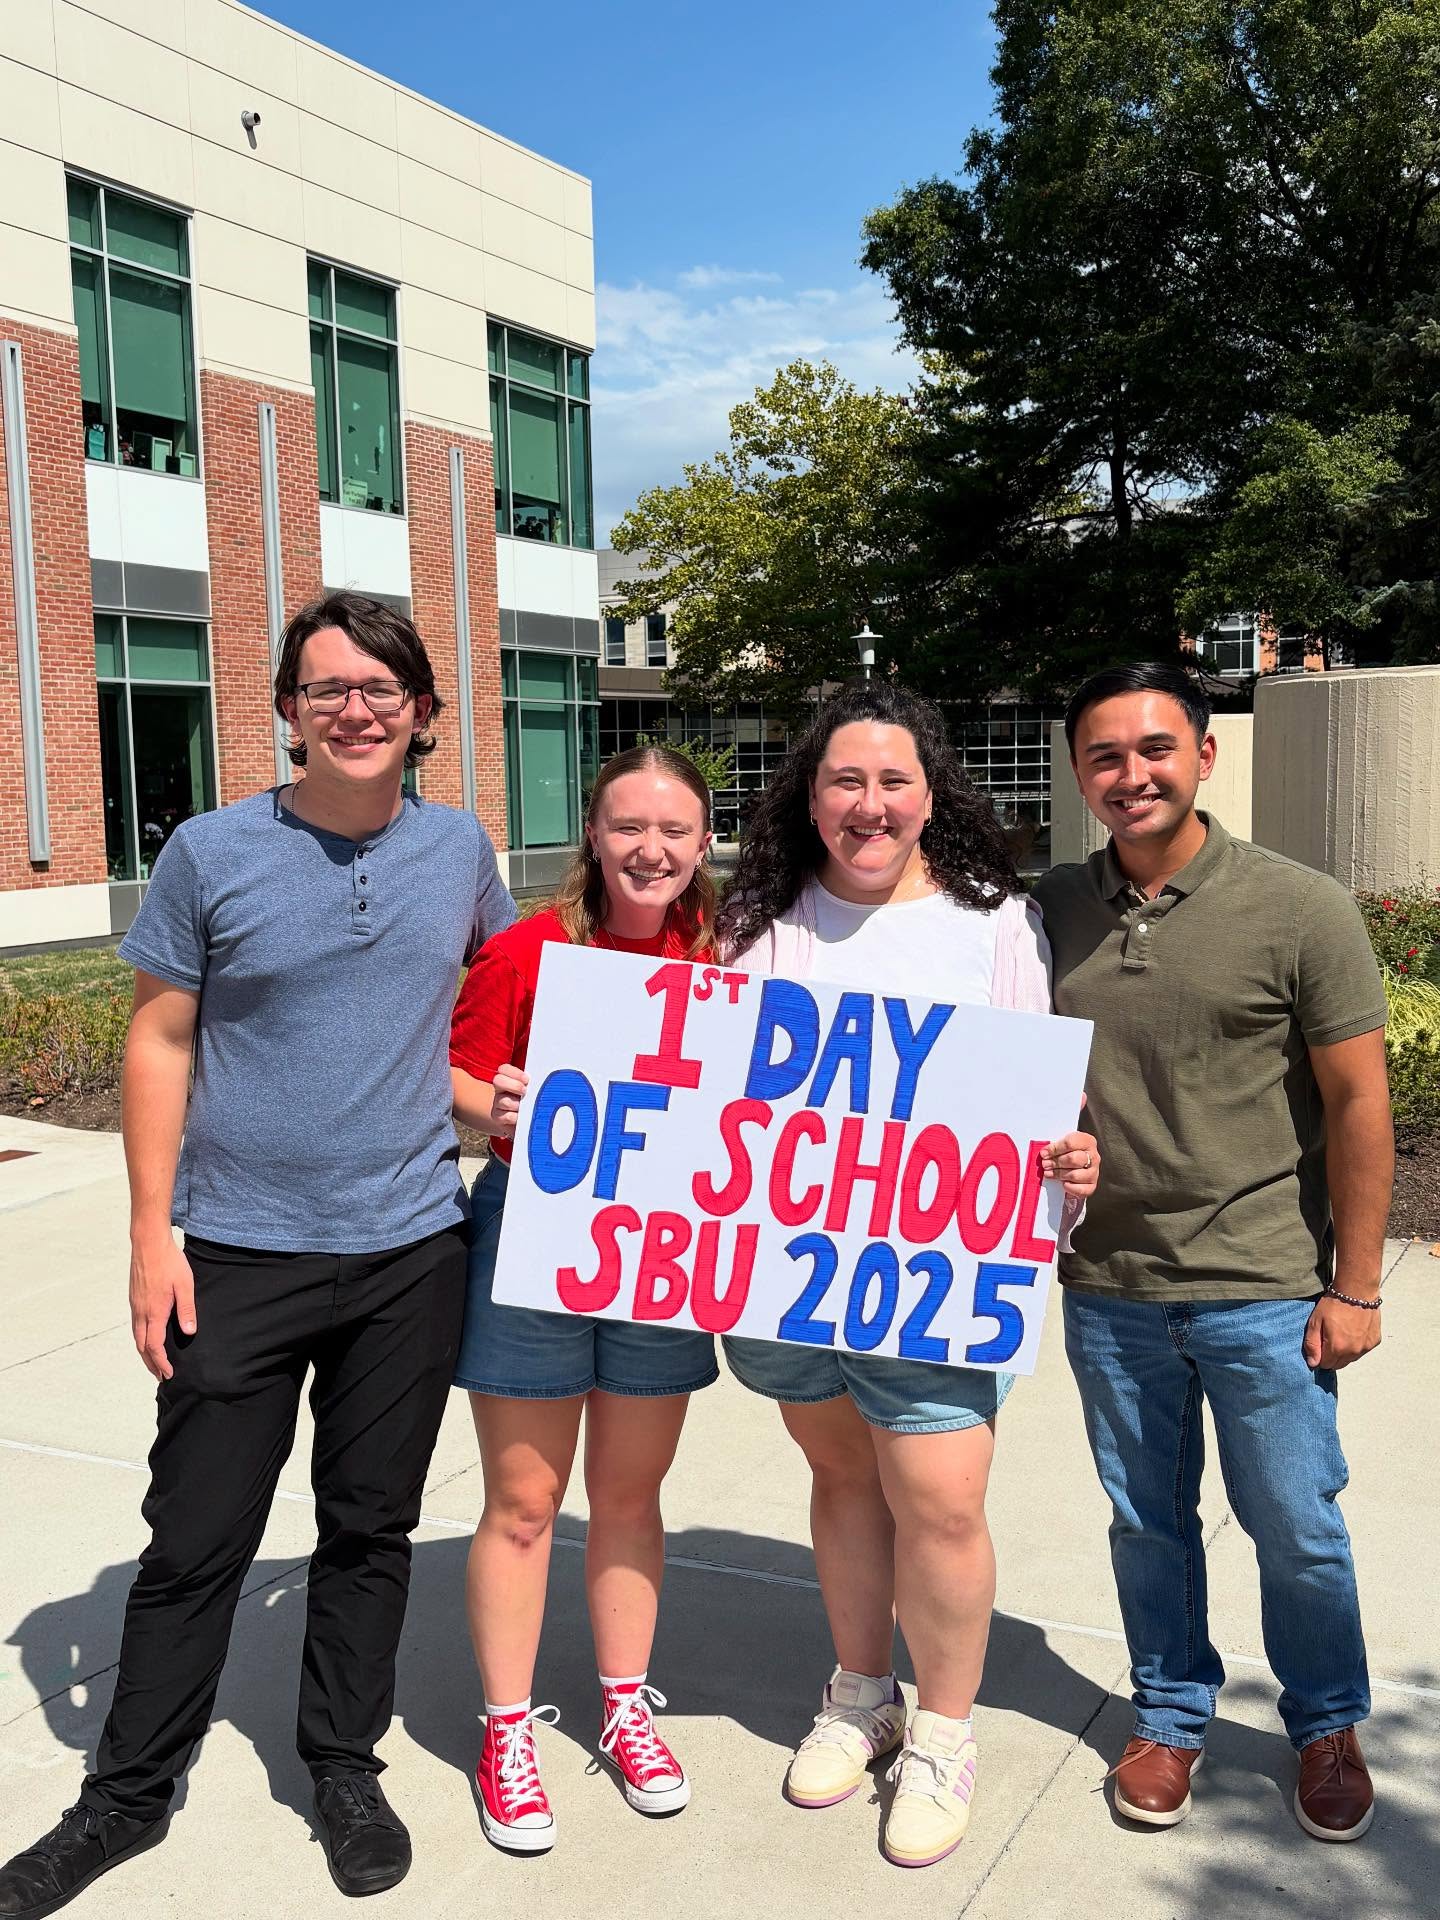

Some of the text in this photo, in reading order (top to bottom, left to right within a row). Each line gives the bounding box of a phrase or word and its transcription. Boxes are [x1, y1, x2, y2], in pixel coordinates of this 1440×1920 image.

[632, 963, 956, 1121] 1ST DAY
[528, 1069, 1055, 1263] OF SCHOOL
[556, 1205, 1038, 1364] SBU 2025
